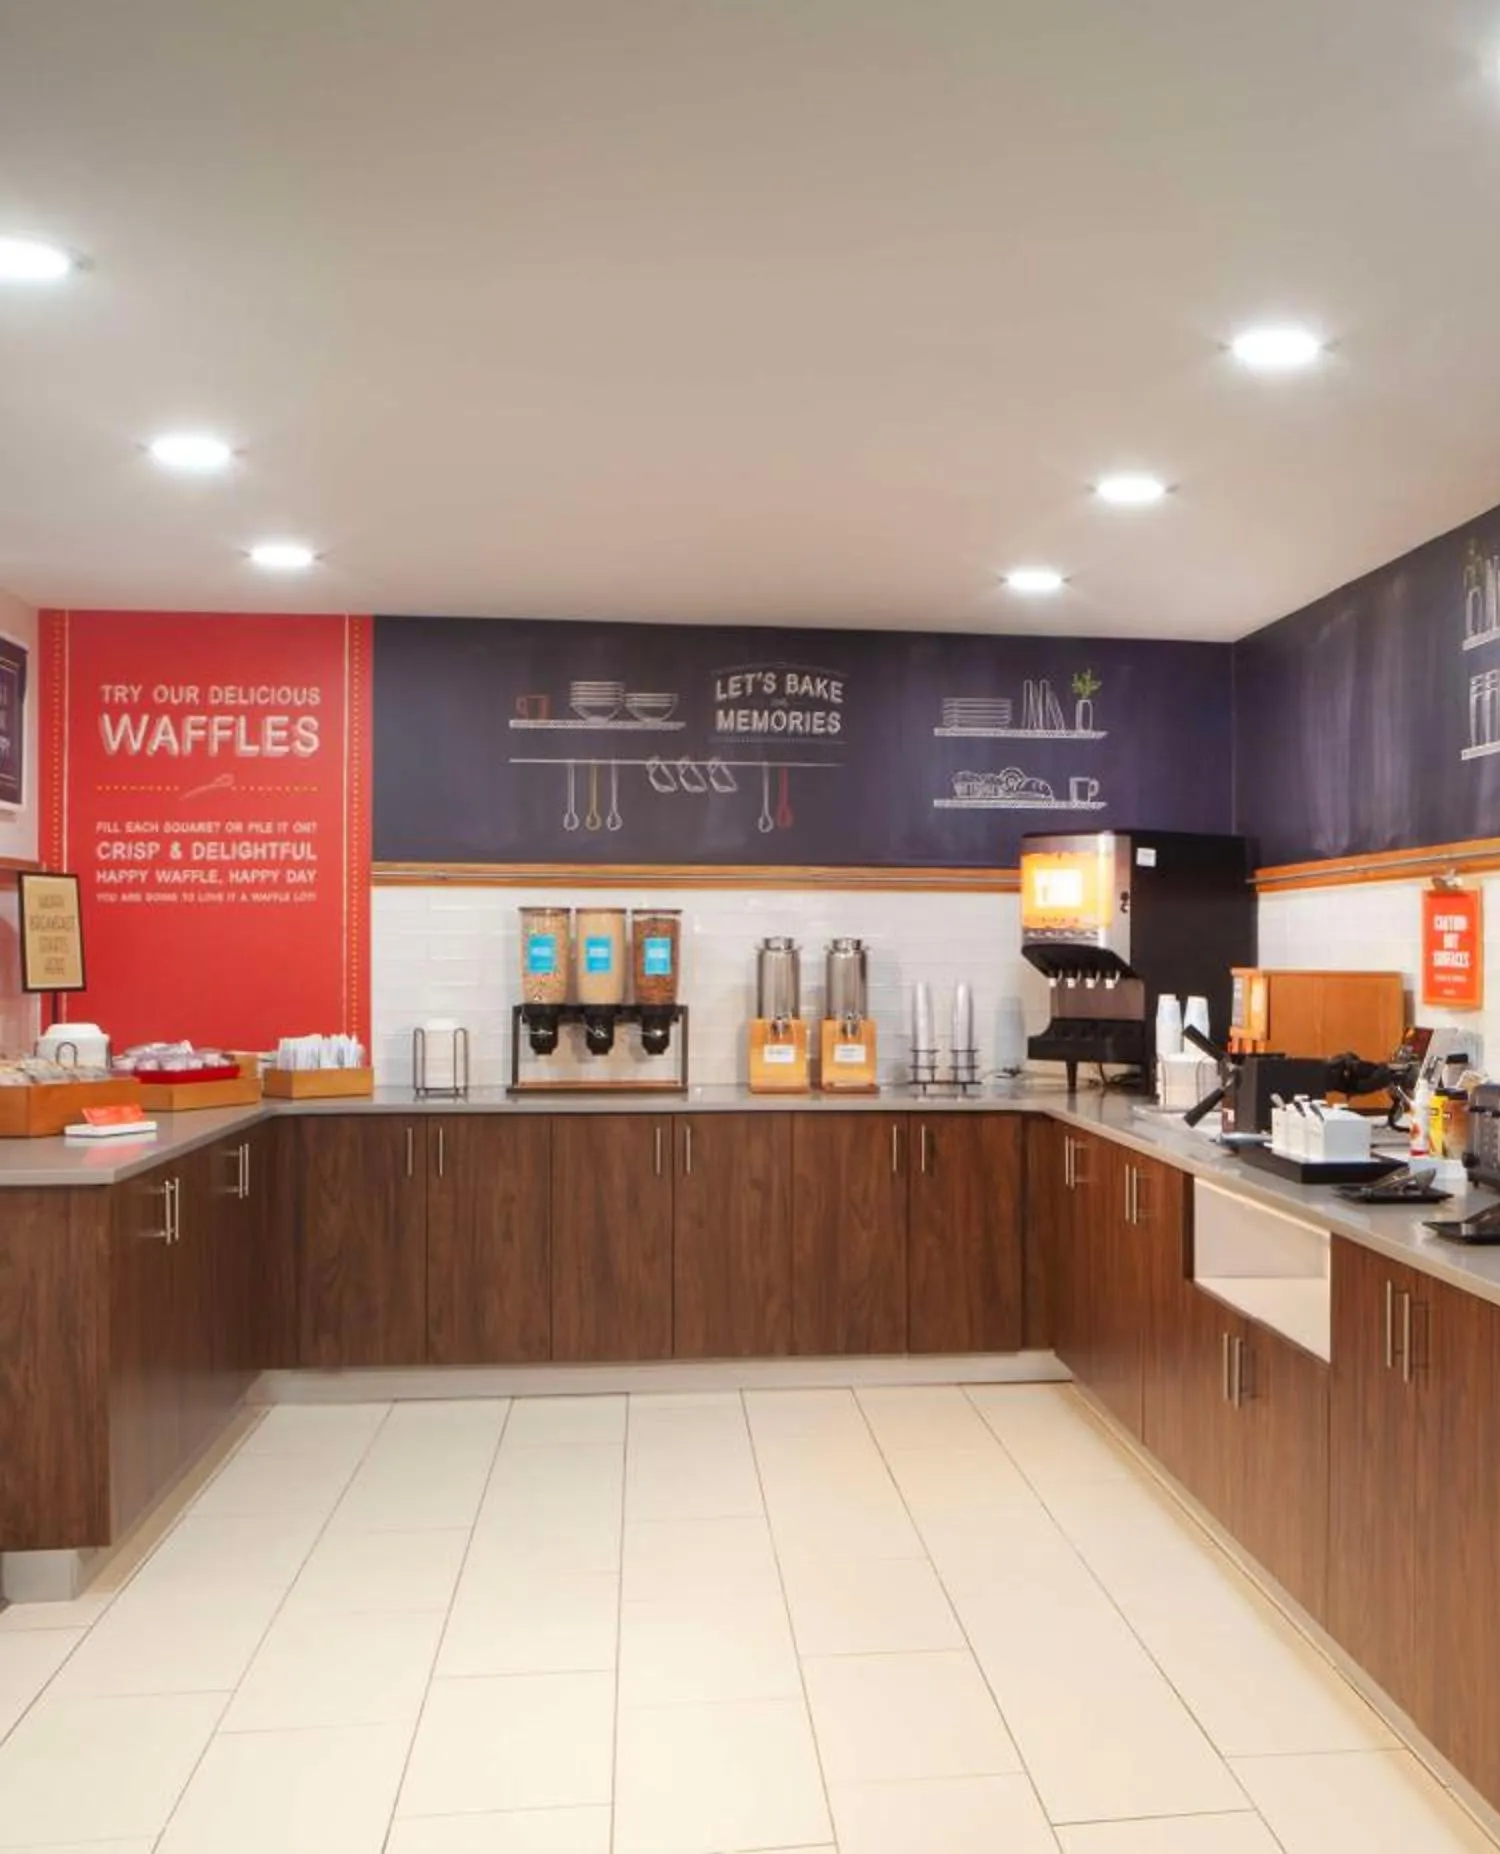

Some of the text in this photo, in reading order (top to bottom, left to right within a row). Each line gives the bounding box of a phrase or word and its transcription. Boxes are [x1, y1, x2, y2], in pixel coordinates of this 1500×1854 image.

[101, 684, 321, 706] TRY OUR DELICIOUS
[715, 671, 845, 704] LET'S BAKE
[715, 709, 842, 735] MEMORIES
[99, 713, 320, 757] WAFFLES
[96, 821, 121, 834] FILL
[125, 821, 160, 834] EACH
[225, 821, 243, 834] OR
[277, 821, 288, 834] IT
[96, 841, 318, 861] CRISP & DELIGHTFUL
[96, 869, 149, 884] HAPPY
[229, 869, 281, 884] HAPPY
[286, 869, 318, 884] DAY
